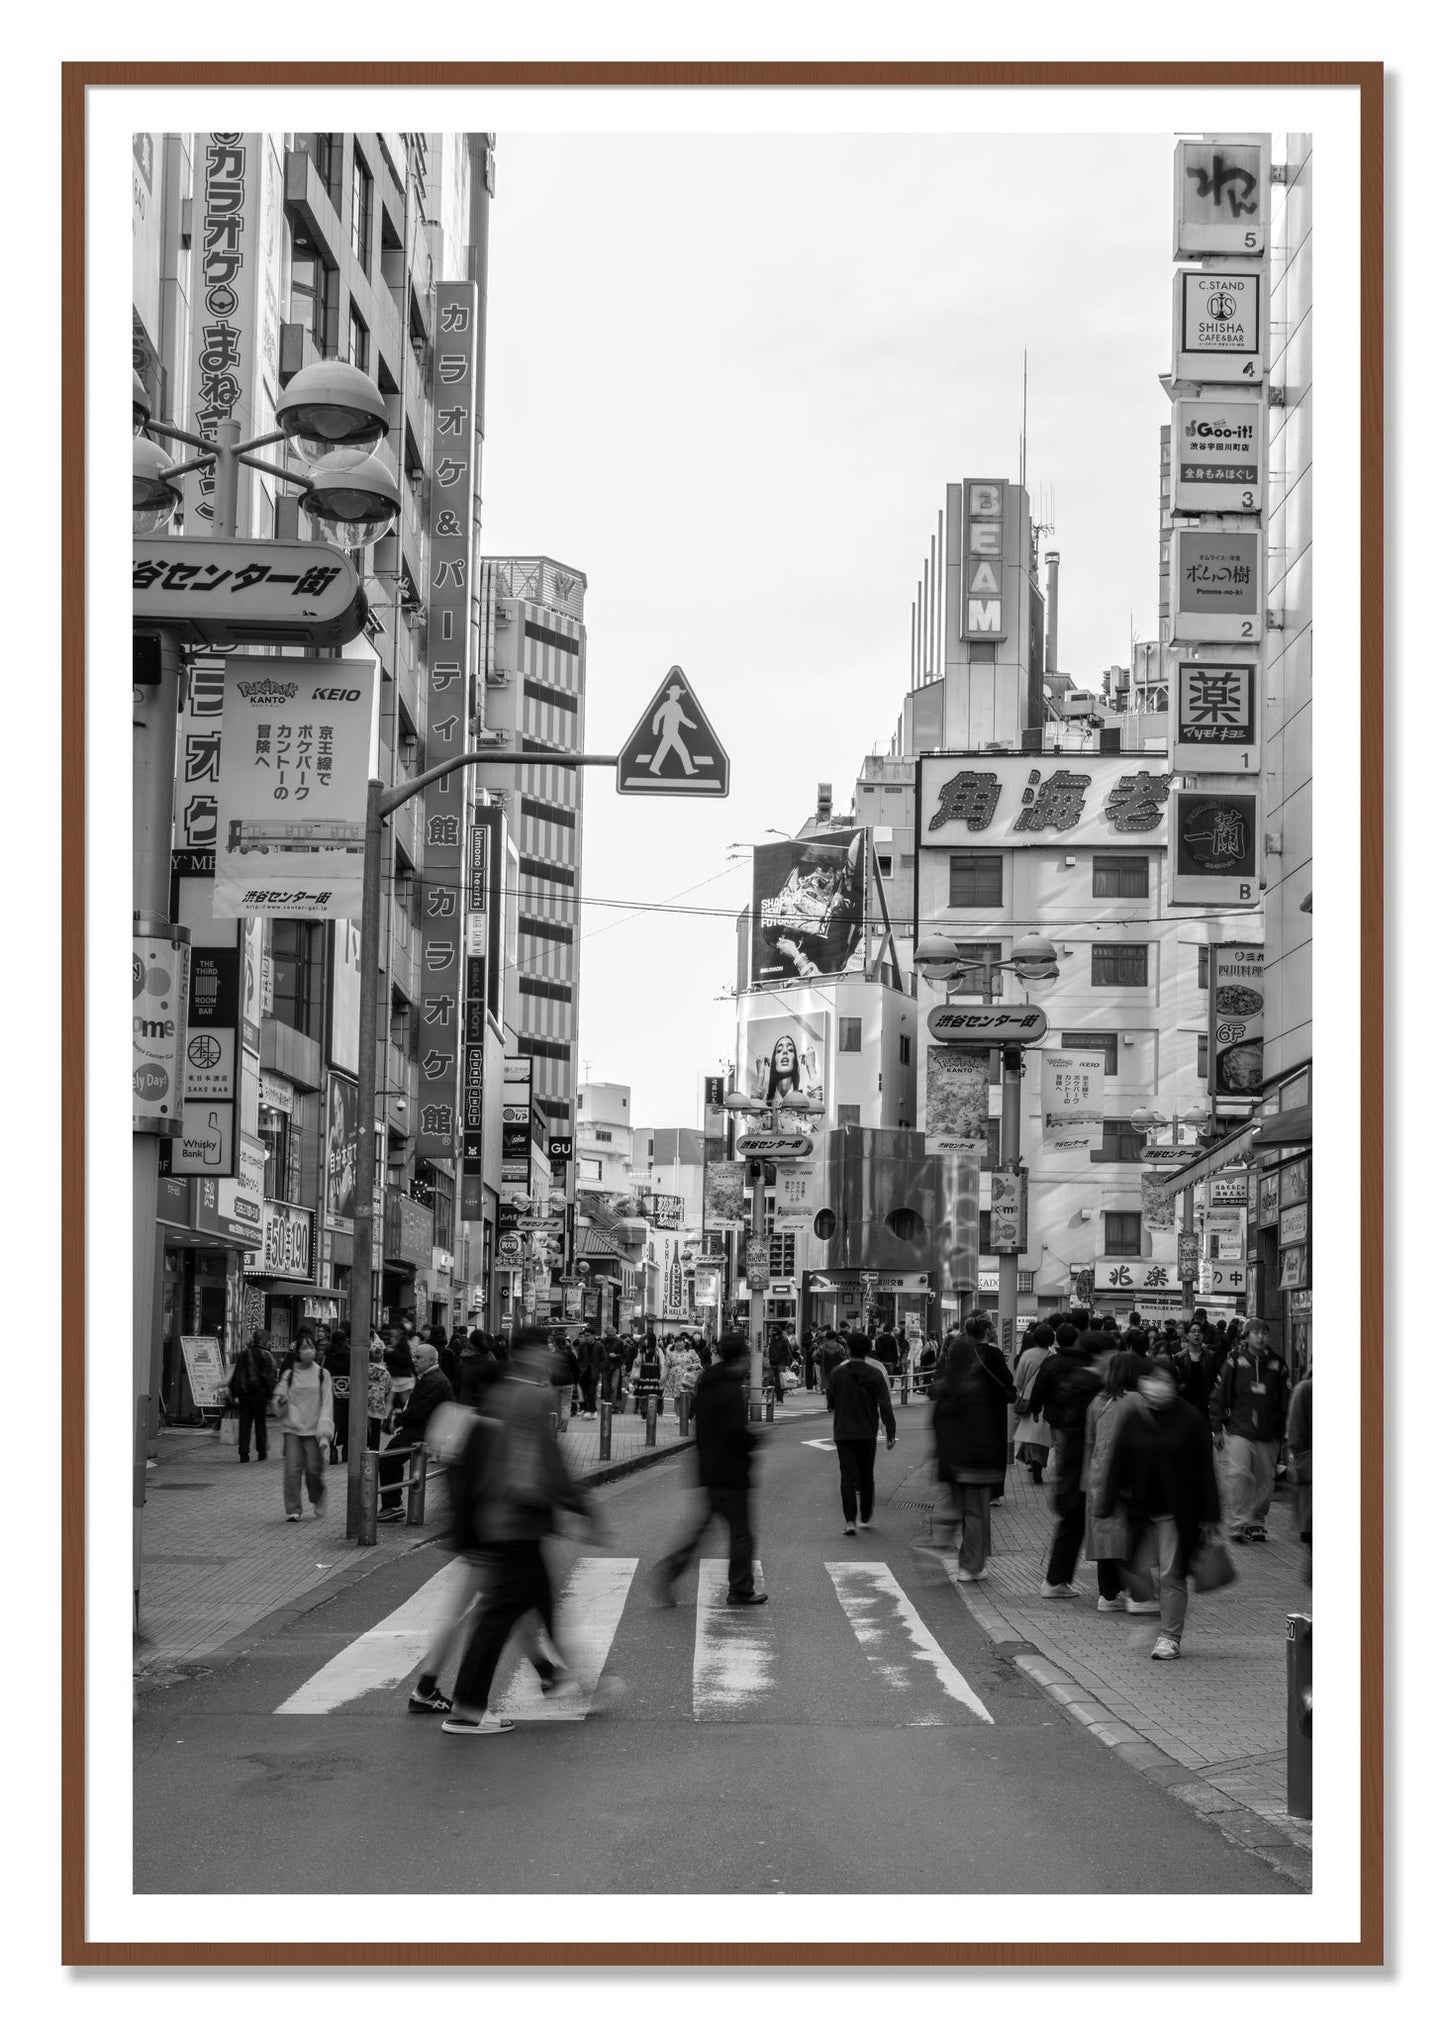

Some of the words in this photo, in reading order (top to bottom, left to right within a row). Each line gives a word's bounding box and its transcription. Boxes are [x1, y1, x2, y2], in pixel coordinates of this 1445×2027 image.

[203, 143, 245, 286] カラオケ
[1244, 231, 1257, 249] 5
[1198, 280, 1245, 291] C.STAND
[1198, 322, 1244, 333] SHISHA
[1198, 333, 1244, 343] CAFE&BAR
[1242, 361, 1255, 377] 4
[1197, 422, 1253, 438] Goo-it!
[1185, 468, 1254, 480] 全身もみほぐし
[1241, 491, 1253, 508] 3
[968, 483, 1002, 633] BEAM
[1185, 564, 1251, 584] ポムの樹
[1240, 621, 1253, 637] 2
[250, 696, 286, 704] KANTO
[311, 687, 361, 702] KEIO
[1188, 670, 1240, 723] 薬
[1183, 726, 1247, 741] マツモトキヨシ
[254, 724, 271, 768] 冒険へ
[273, 724, 293, 801] カントーの
[294, 724, 313, 801] ポケパーク
[316, 725, 335, 787] 京王線で
[1240, 752, 1249, 769] 1
[928, 769, 1173, 833] 角海老
[1183, 809, 1246, 859] 一蘭
[474, 830, 483, 867] kimono
[241, 890, 332, 904] 渋谷センター街
[1239, 883, 1251, 900] B
[195, 967, 218, 976] THIRD
[199, 960, 214, 968] THE
[1218, 964, 1264, 978] 四川料理
[195, 997, 217, 1005] ROOM
[198, 1007, 214, 1015] BAR
[934, 1015, 1040, 1029] 渋谷センター街
[1215, 1022, 1246, 1044] 6F
[183, 1139, 217, 1151] Whisky
[550, 1142, 571, 1154] GU
[738, 1140, 804, 1151] 渋谷センター街
[182, 1149, 203, 1158] Bank
[1144, 1149, 1203, 1159] 渋谷センター街
[1107, 1264, 1170, 1287] 兆楽
[670, 1263, 681, 1307] BEER
